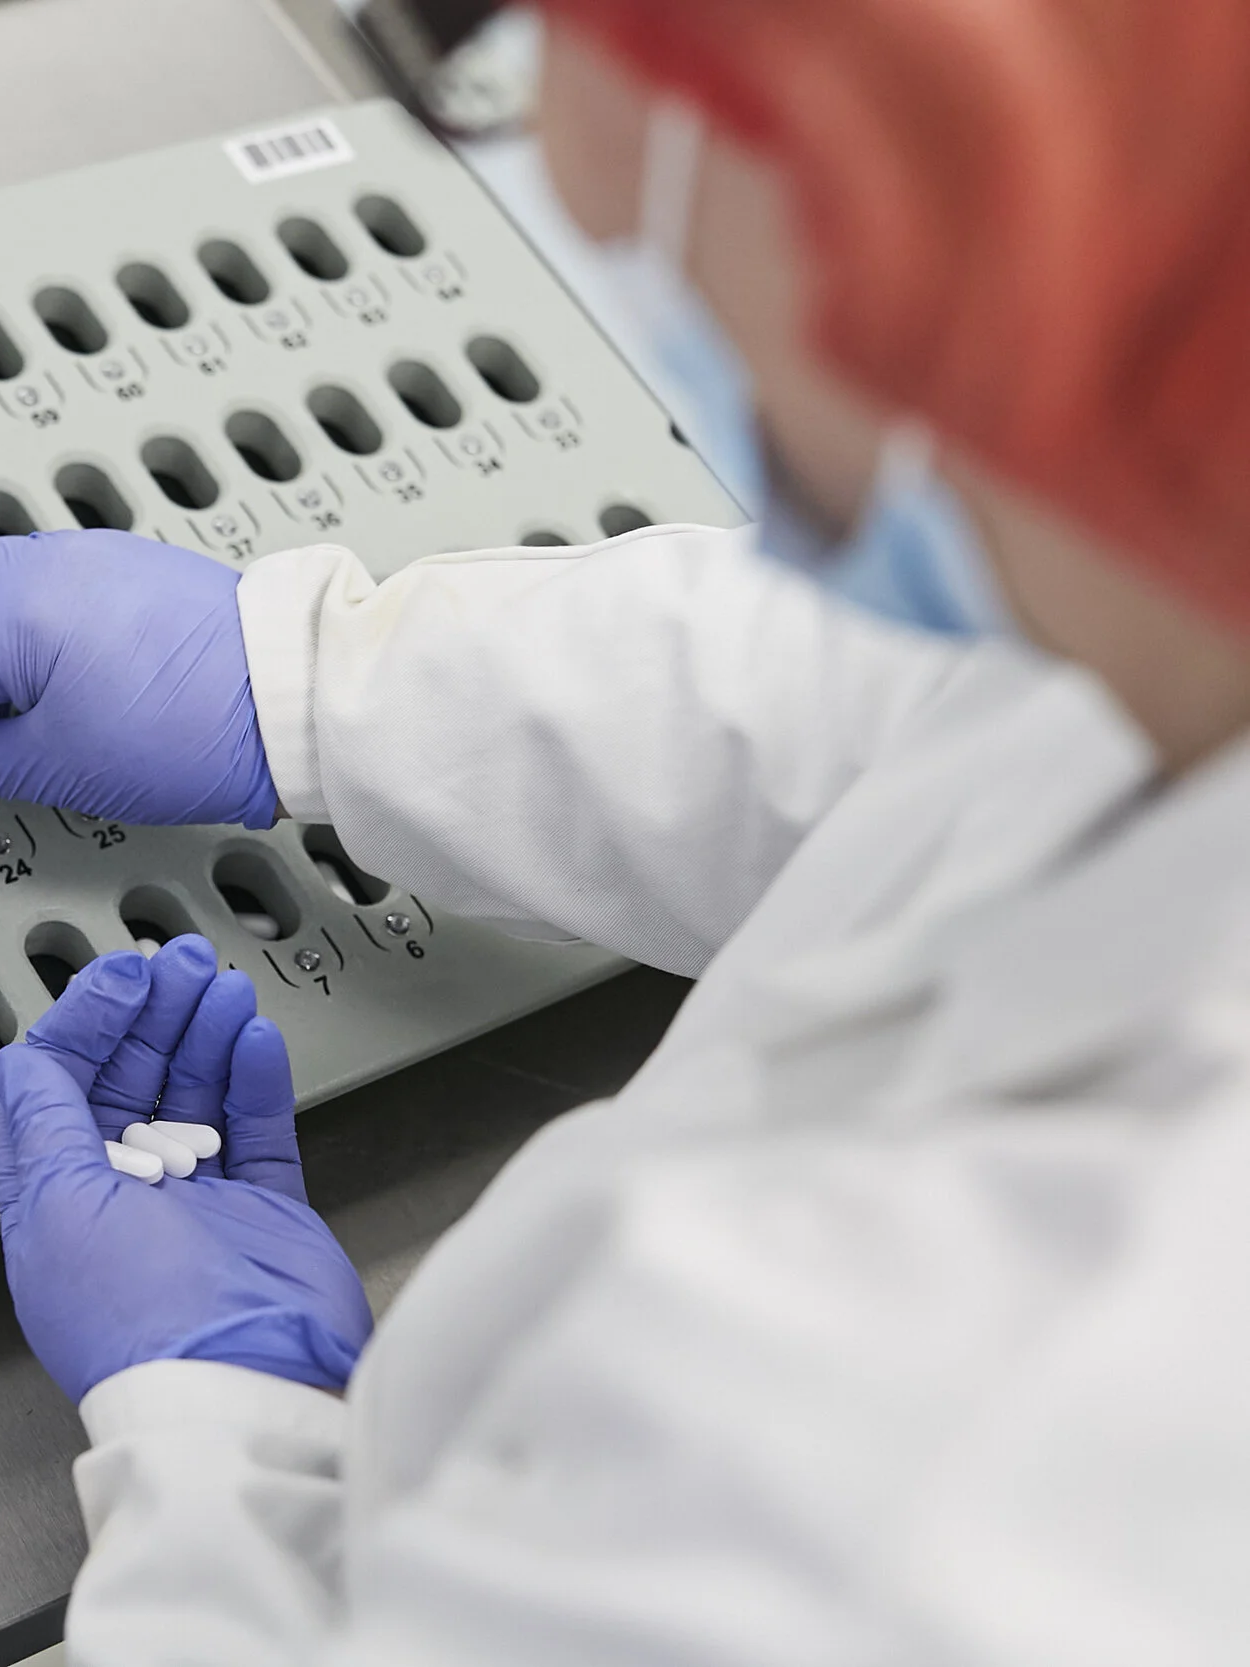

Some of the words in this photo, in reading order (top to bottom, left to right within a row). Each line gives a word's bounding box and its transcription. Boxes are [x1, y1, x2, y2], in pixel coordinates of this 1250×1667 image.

[30, 409, 60, 428] 59
[312, 511, 342, 531] 36
[227, 537, 254, 560] 37
[91, 823, 127, 850] 25
[405, 939, 425, 960] 6
[313, 974, 331, 996] 7
